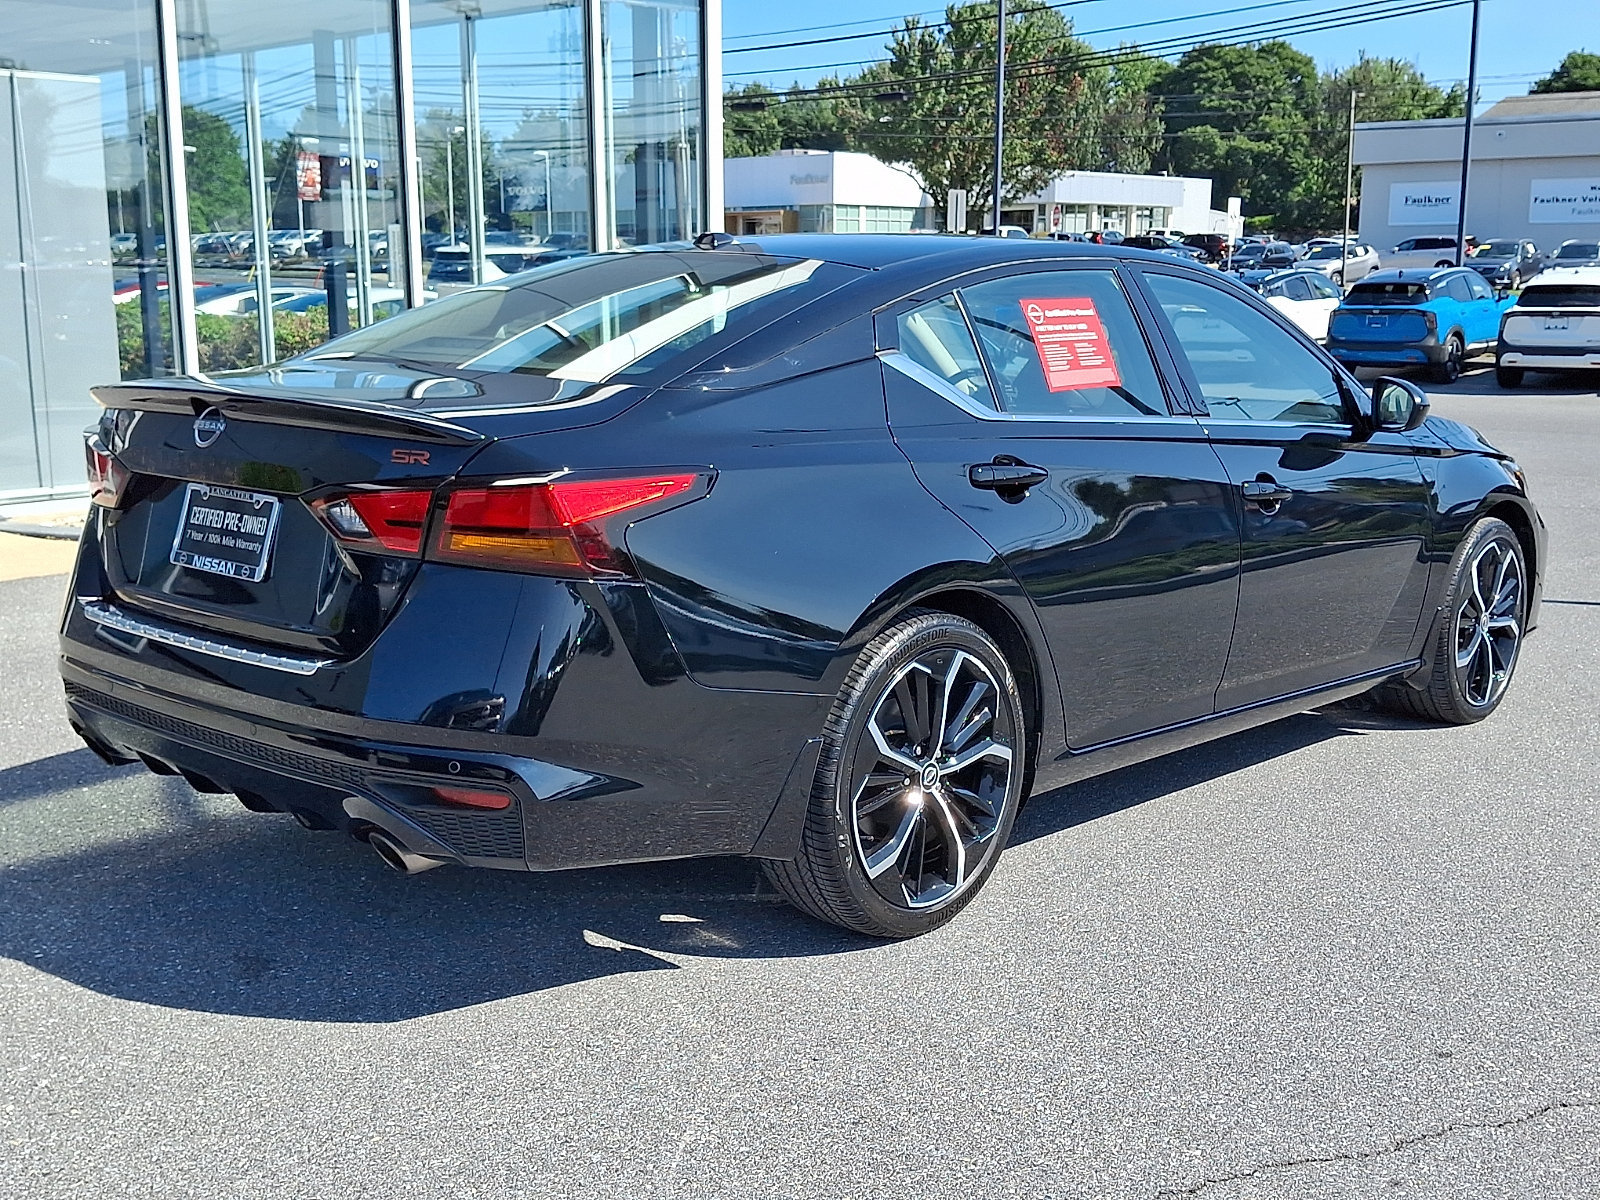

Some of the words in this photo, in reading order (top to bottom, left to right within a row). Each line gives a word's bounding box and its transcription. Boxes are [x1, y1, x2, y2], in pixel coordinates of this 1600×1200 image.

[1404, 195, 1452, 205] Faulkner
[1534, 196, 1577, 204] Faulkner
[391, 449, 430, 466] SR
[211, 486, 251, 500] LANCASTER
[190, 506, 225, 528] CERTIFIED
[223, 511, 268, 536] PRE-OWNED
[186, 529, 192, 538] 7
[191, 530, 204, 541] Year
[208, 533, 221, 544] 100k
[222, 536, 235, 547] Mile
[236, 538, 262, 554] Warranty
[192, 555, 236, 575] NISSAN
[885, 627, 950, 669] BRIDGESTONE
